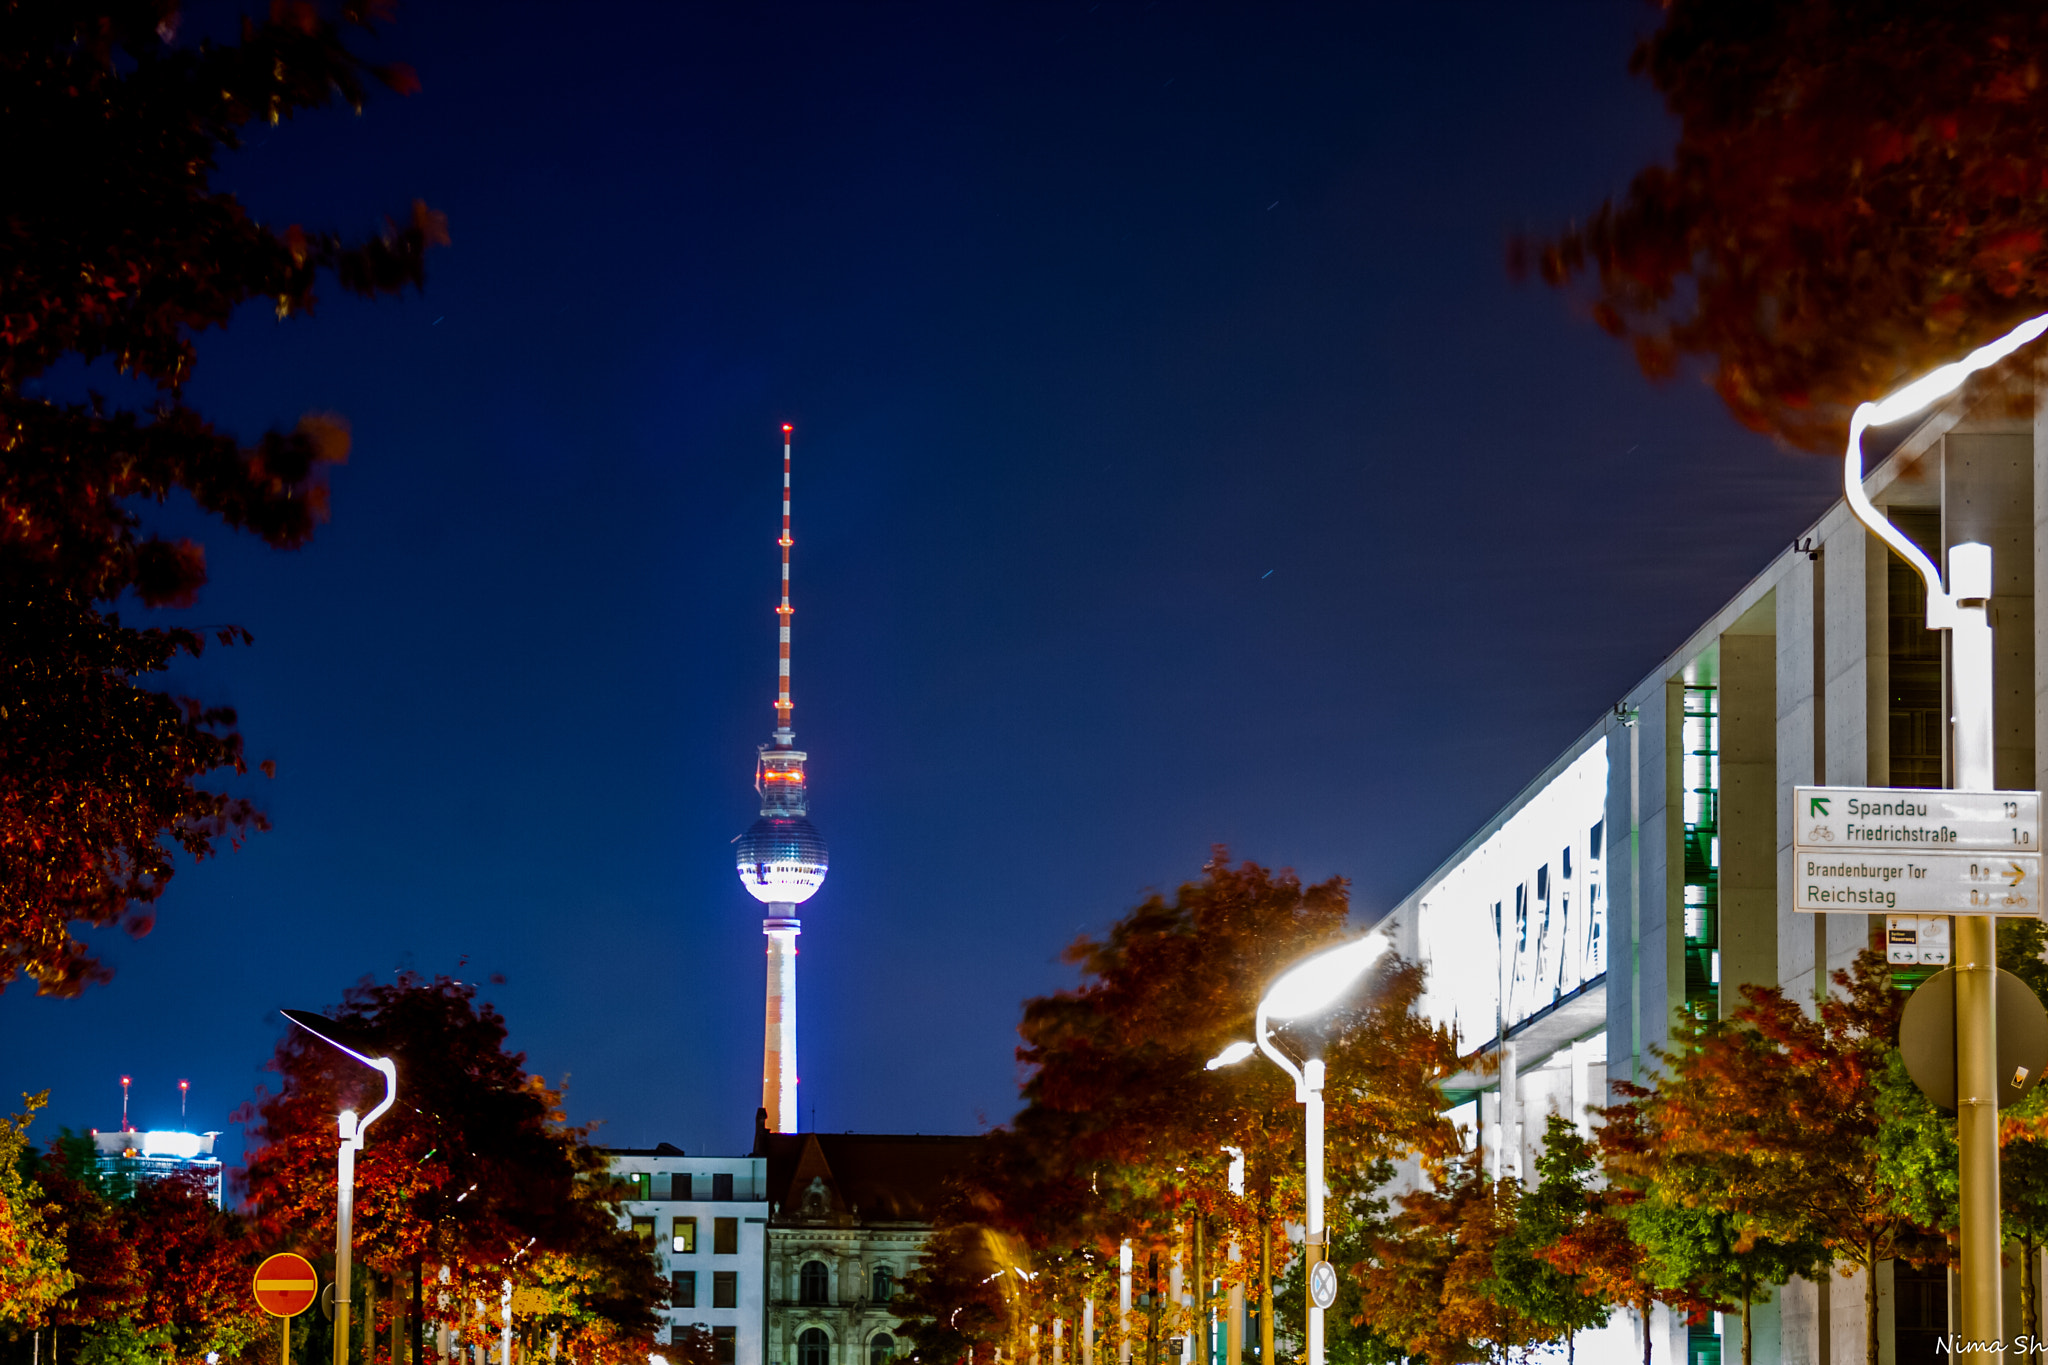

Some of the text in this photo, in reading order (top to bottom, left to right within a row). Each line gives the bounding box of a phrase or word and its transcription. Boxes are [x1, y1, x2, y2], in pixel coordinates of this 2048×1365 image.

[1848, 799, 1927, 819] Spandau
[1847, 824, 1957, 842] Friedrichstraße
[1808, 861, 1903, 881] Brandenburger
[1908, 864, 1927, 879] Tor
[1808, 886, 1896, 908] Reichstag
